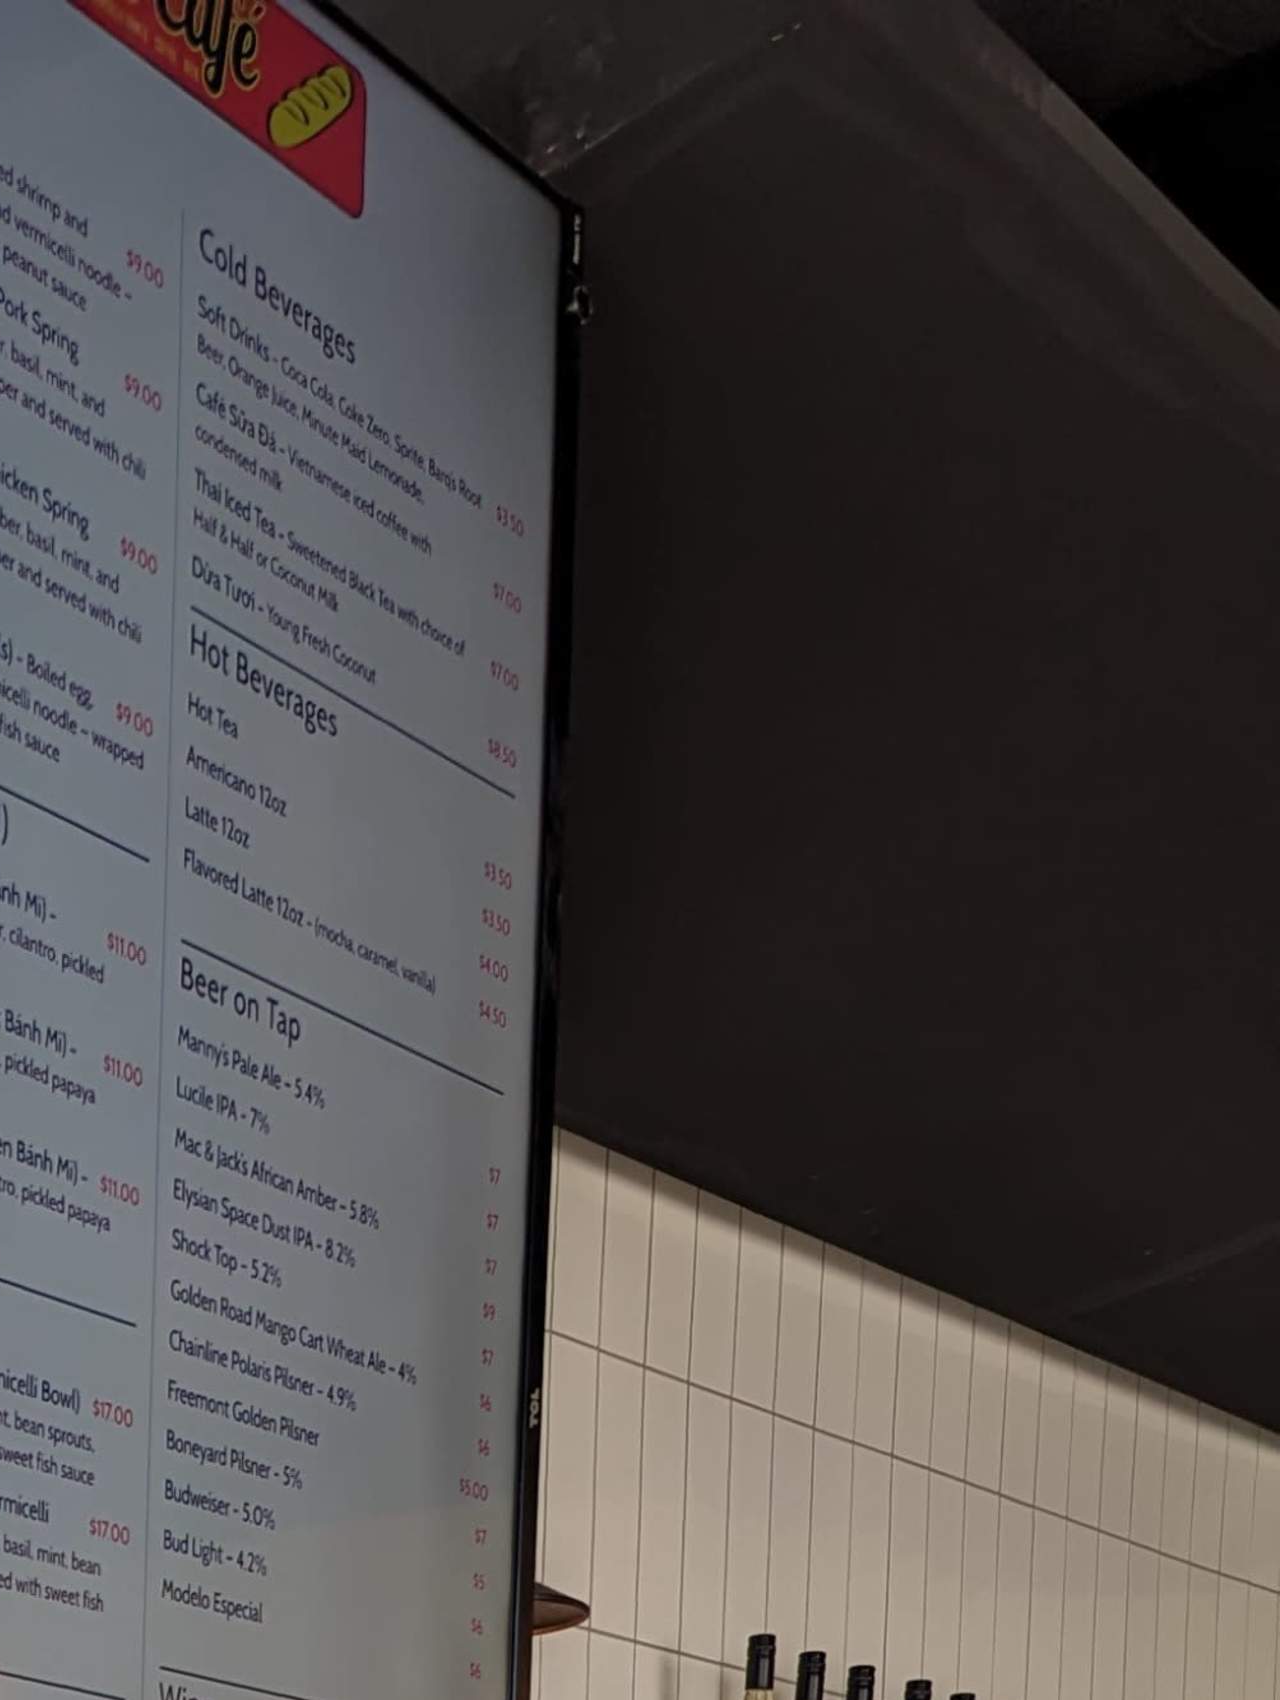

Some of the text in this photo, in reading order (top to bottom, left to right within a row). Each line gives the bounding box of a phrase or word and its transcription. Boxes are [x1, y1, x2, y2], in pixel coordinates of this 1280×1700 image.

[198, 227, 356, 365] Cold Beverages
[31, 309, 80, 366] Spring
[123, 372, 163, 412] $9.00
[189, 622, 338, 737] Hot Beverages
[187, 690, 239, 740] Hot Tea
[185, 744, 287, 818] Americano 12oz
[184, 794, 251, 850] Latte 12oz
[483, 860, 513, 891] $3.50
[480, 906, 512, 937] $3.50
[106, 931, 148, 967] $11.00
[478, 953, 509, 983] $4.00
[180, 955, 302, 1049] Beer on Tap
[20, 1183, 66, 1215] pickled
[66, 1202, 111, 1234] papaya
[40, 1379, 81, 1416] Bowl)
[91, 1397, 134, 1429] $17.00
[166, 1377, 320, 1447] Freemont Golden Pilsner
[35, 1449, 58, 1476] fish
[59, 1463, 95, 1487] sauce
[458, 1476, 489, 1502] $5.00
[160, 1577, 263, 1624] Modelo Especial
